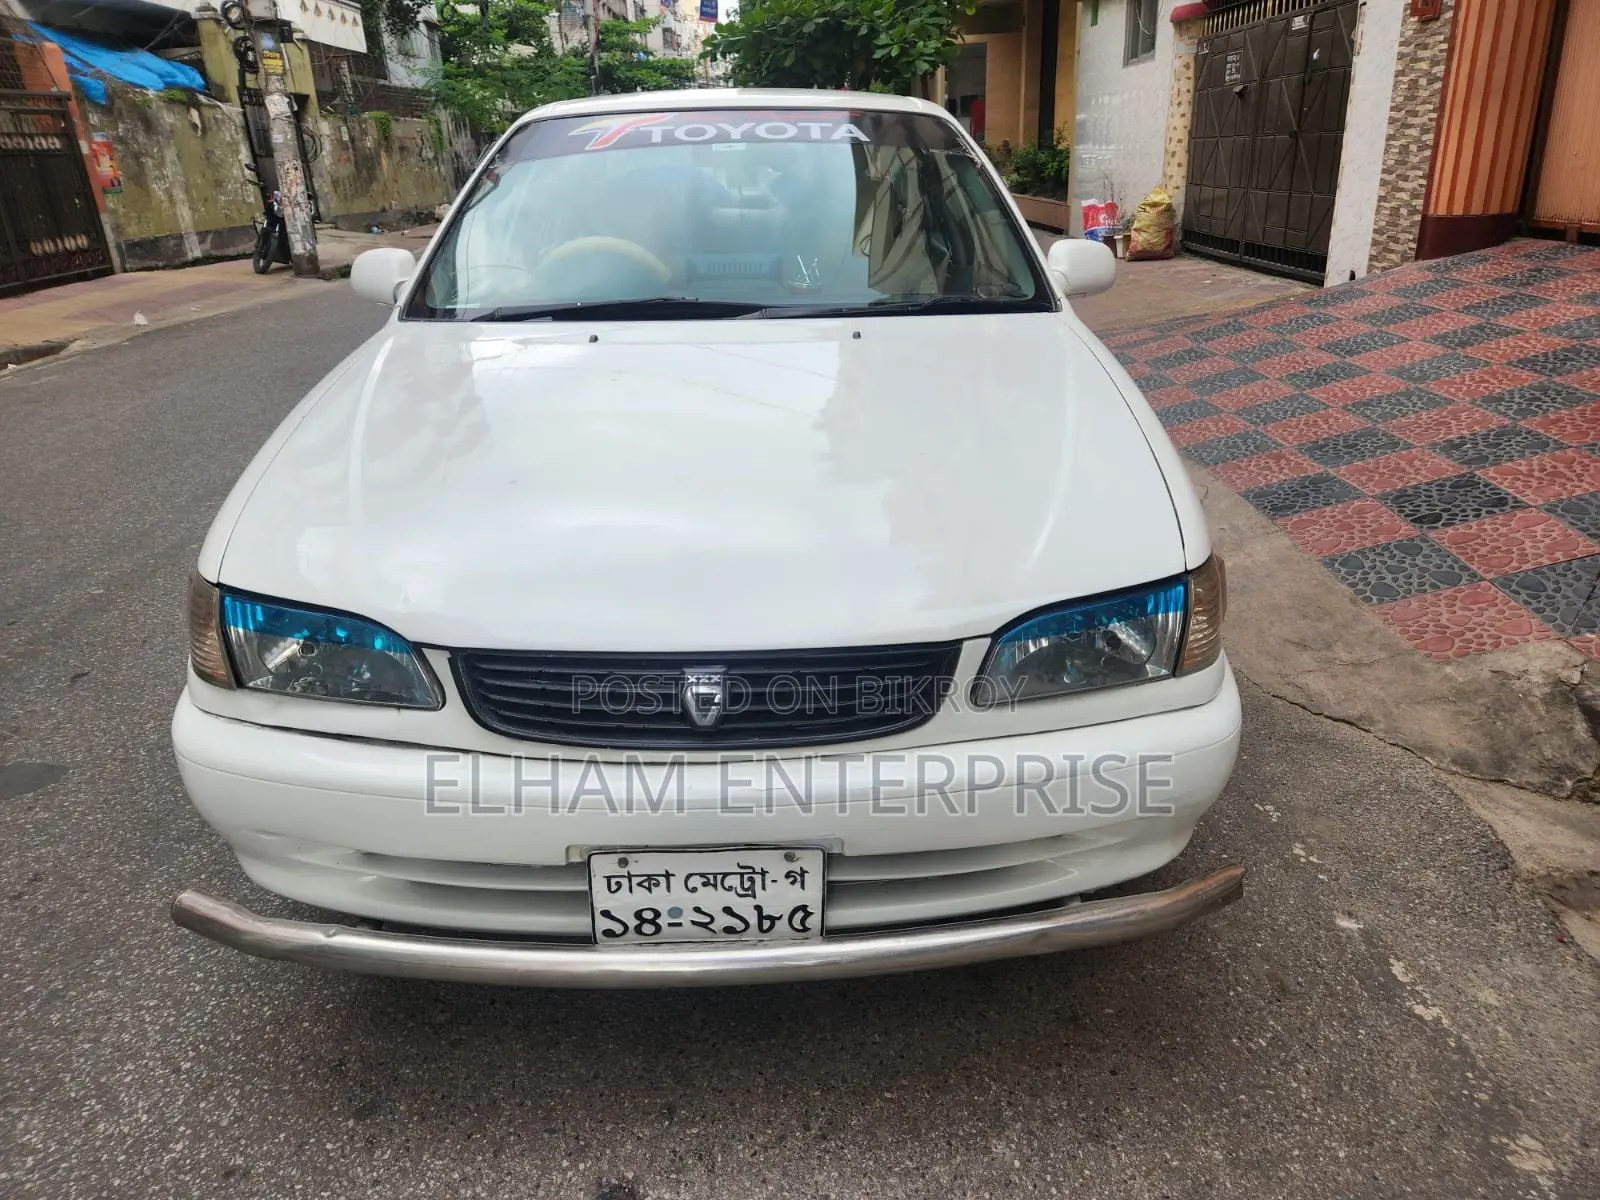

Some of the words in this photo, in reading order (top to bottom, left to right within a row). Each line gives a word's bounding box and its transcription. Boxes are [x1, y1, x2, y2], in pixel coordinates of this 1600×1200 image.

[639, 121, 871, 144] TOYOTA
[603, 869, 676, 895] ঢাকা
[599, 903, 815, 938] ১৪-২১৮৫
